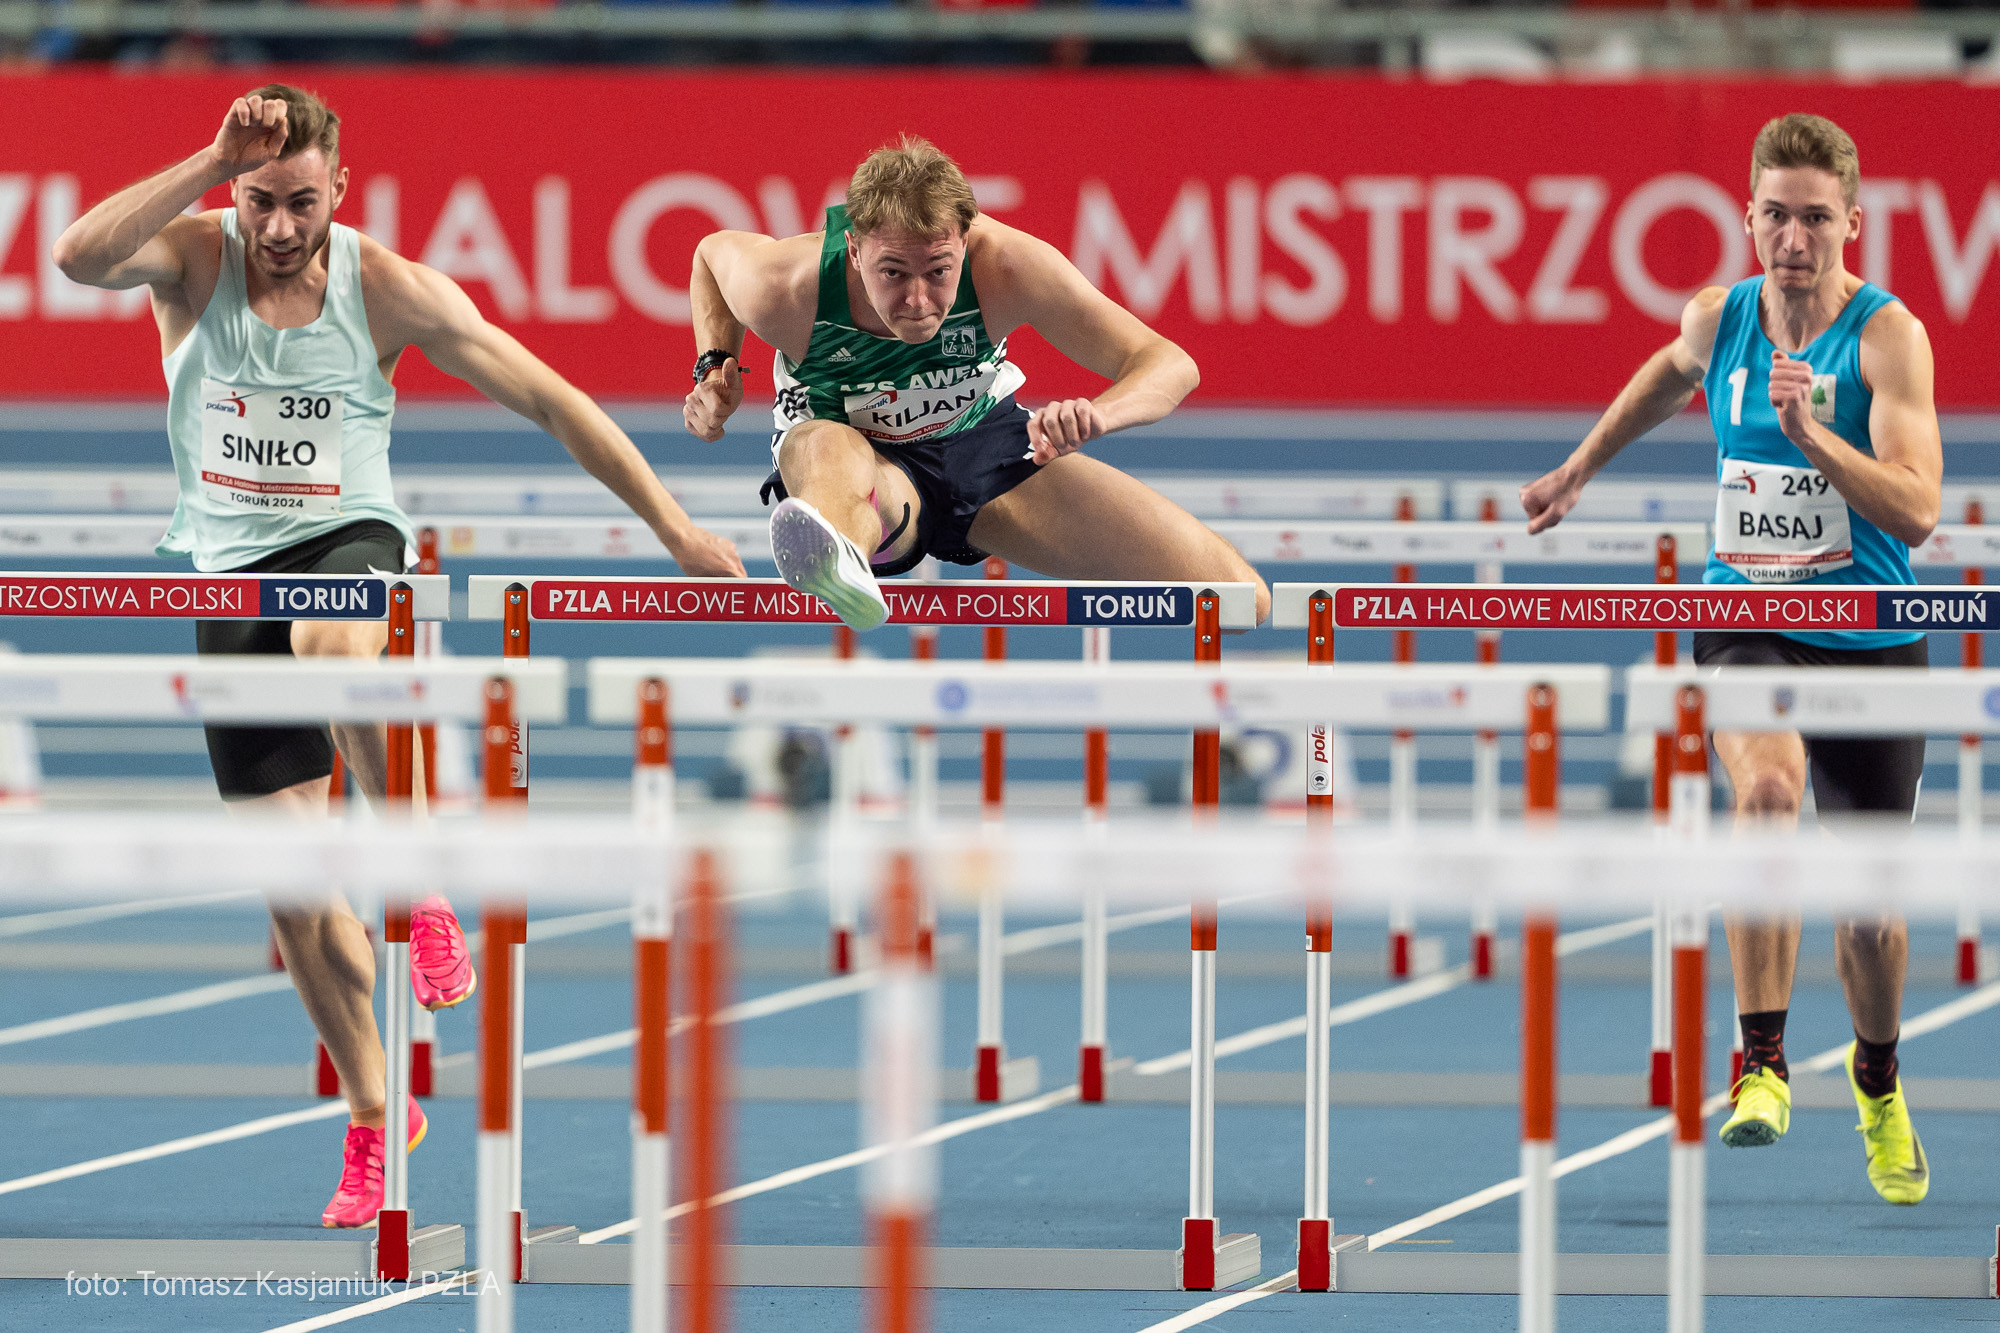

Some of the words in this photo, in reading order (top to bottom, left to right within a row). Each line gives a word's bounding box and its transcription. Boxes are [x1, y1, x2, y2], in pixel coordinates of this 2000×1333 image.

[1072, 172, 2000, 326] MISTRZOTW
[205, 402, 236, 414] polanik
[278, 396, 331, 420] 330
[872, 388, 977, 428] KILJAN
[1728, 367, 1748, 426] 1
[222, 433, 316, 466] SINIŁO
[230, 492, 269, 507] TORUŃ
[272, 498, 304, 508] 2024
[311, 486, 336, 494] Polski
[1781, 475, 1829, 496] 249
[1739, 511, 1823, 540] BASAJ
[150, 587, 242, 610] POLSKI
[276, 580, 368, 611] TORUŃ
[549, 589, 612, 613] PZLA
[622, 590, 745, 615] HALOWE
[754, 591, 947, 617] MISTRTWA
[957, 594, 1049, 618] POLSKI
[1083, 588, 1176, 618] TORUŃ
[1353, 596, 1417, 620] PZLA
[1427, 597, 1551, 621] HALOWE
[1559, 597, 1756, 622] MISTRZOSTWA
[1765, 598, 1859, 623] POLSKI
[1892, 592, 1987, 623] TORUŃ
